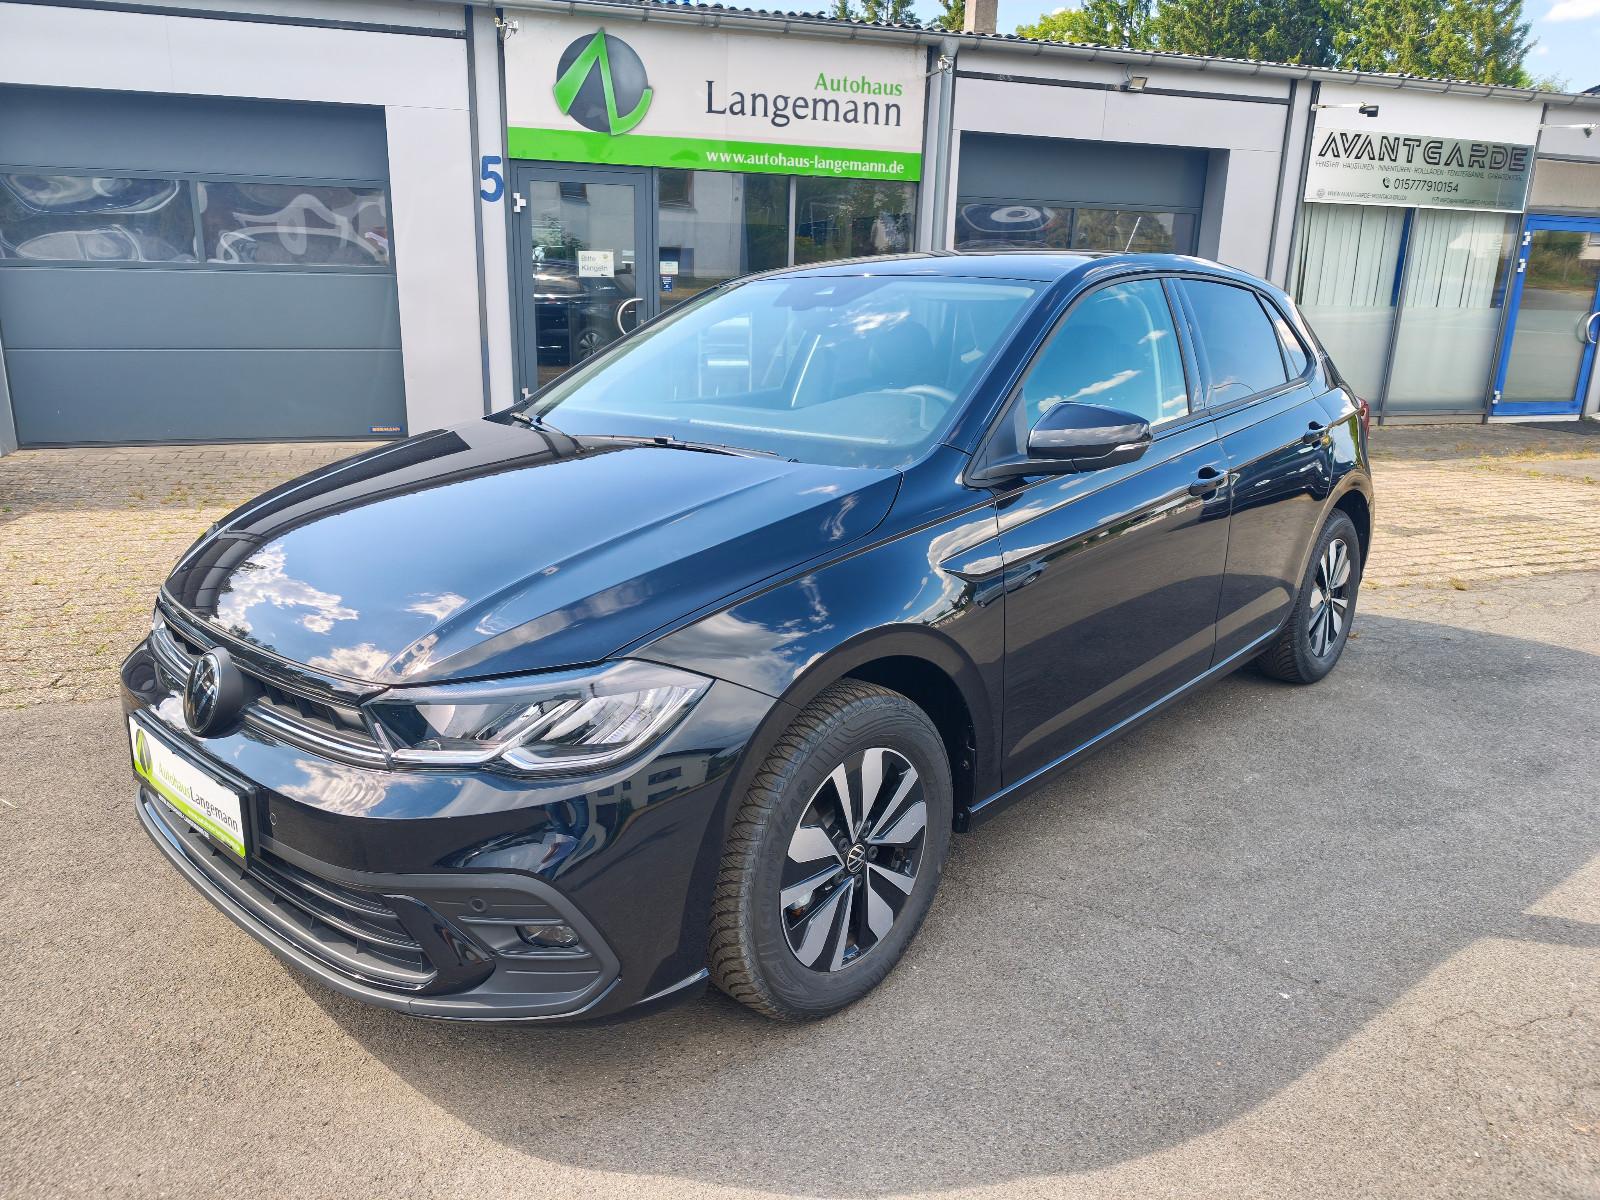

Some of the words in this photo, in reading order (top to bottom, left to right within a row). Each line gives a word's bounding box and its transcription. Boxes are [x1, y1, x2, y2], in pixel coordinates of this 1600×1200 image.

[814, 72, 903, 96] Autohaus
[705, 80, 901, 127] Langemann
[705, 151, 905, 173] www.autohaus-langemann.de
[1318, 131, 1529, 172] AVANTGARDE
[480, 155, 505, 202] 5
[1393, 178, 1459, 192] 015777910154
